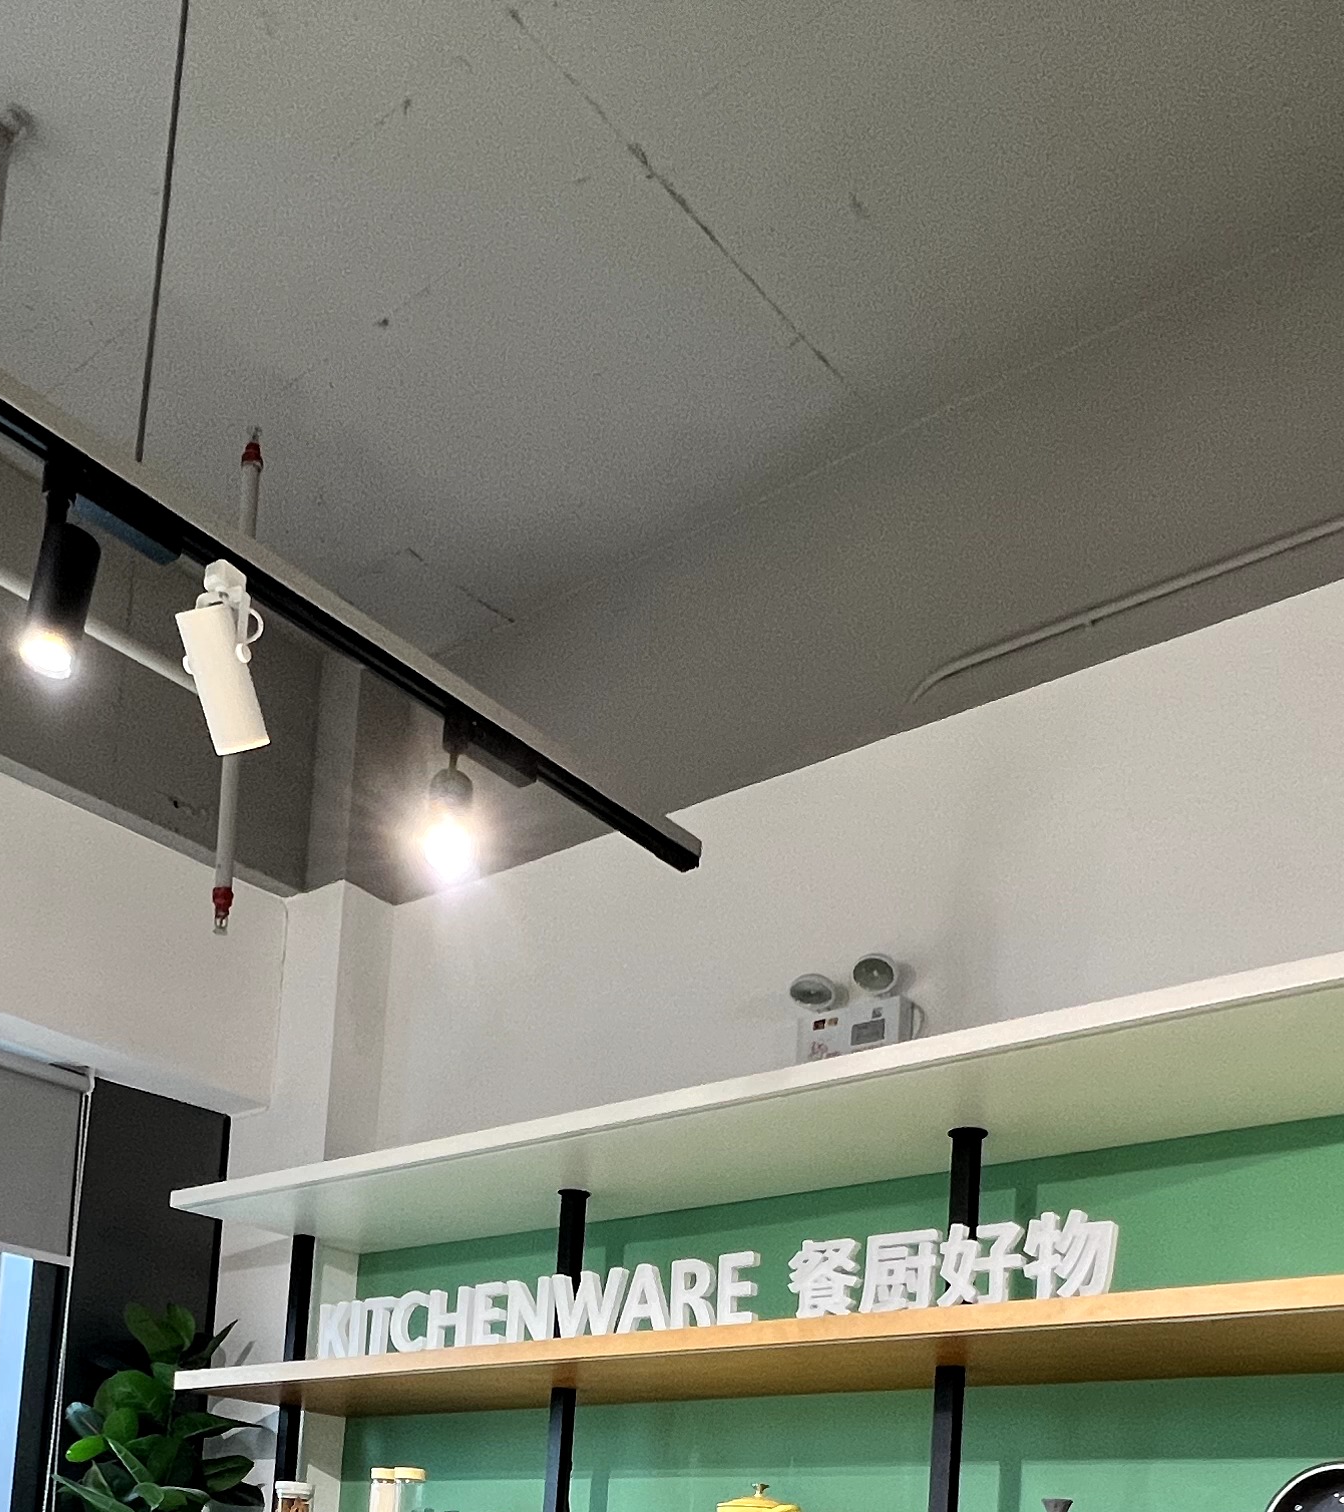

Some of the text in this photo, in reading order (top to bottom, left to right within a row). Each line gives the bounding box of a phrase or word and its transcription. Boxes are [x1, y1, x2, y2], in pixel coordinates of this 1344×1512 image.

[317, 1208, 1120, 1361] KITCHENWARE 餐厨好物
